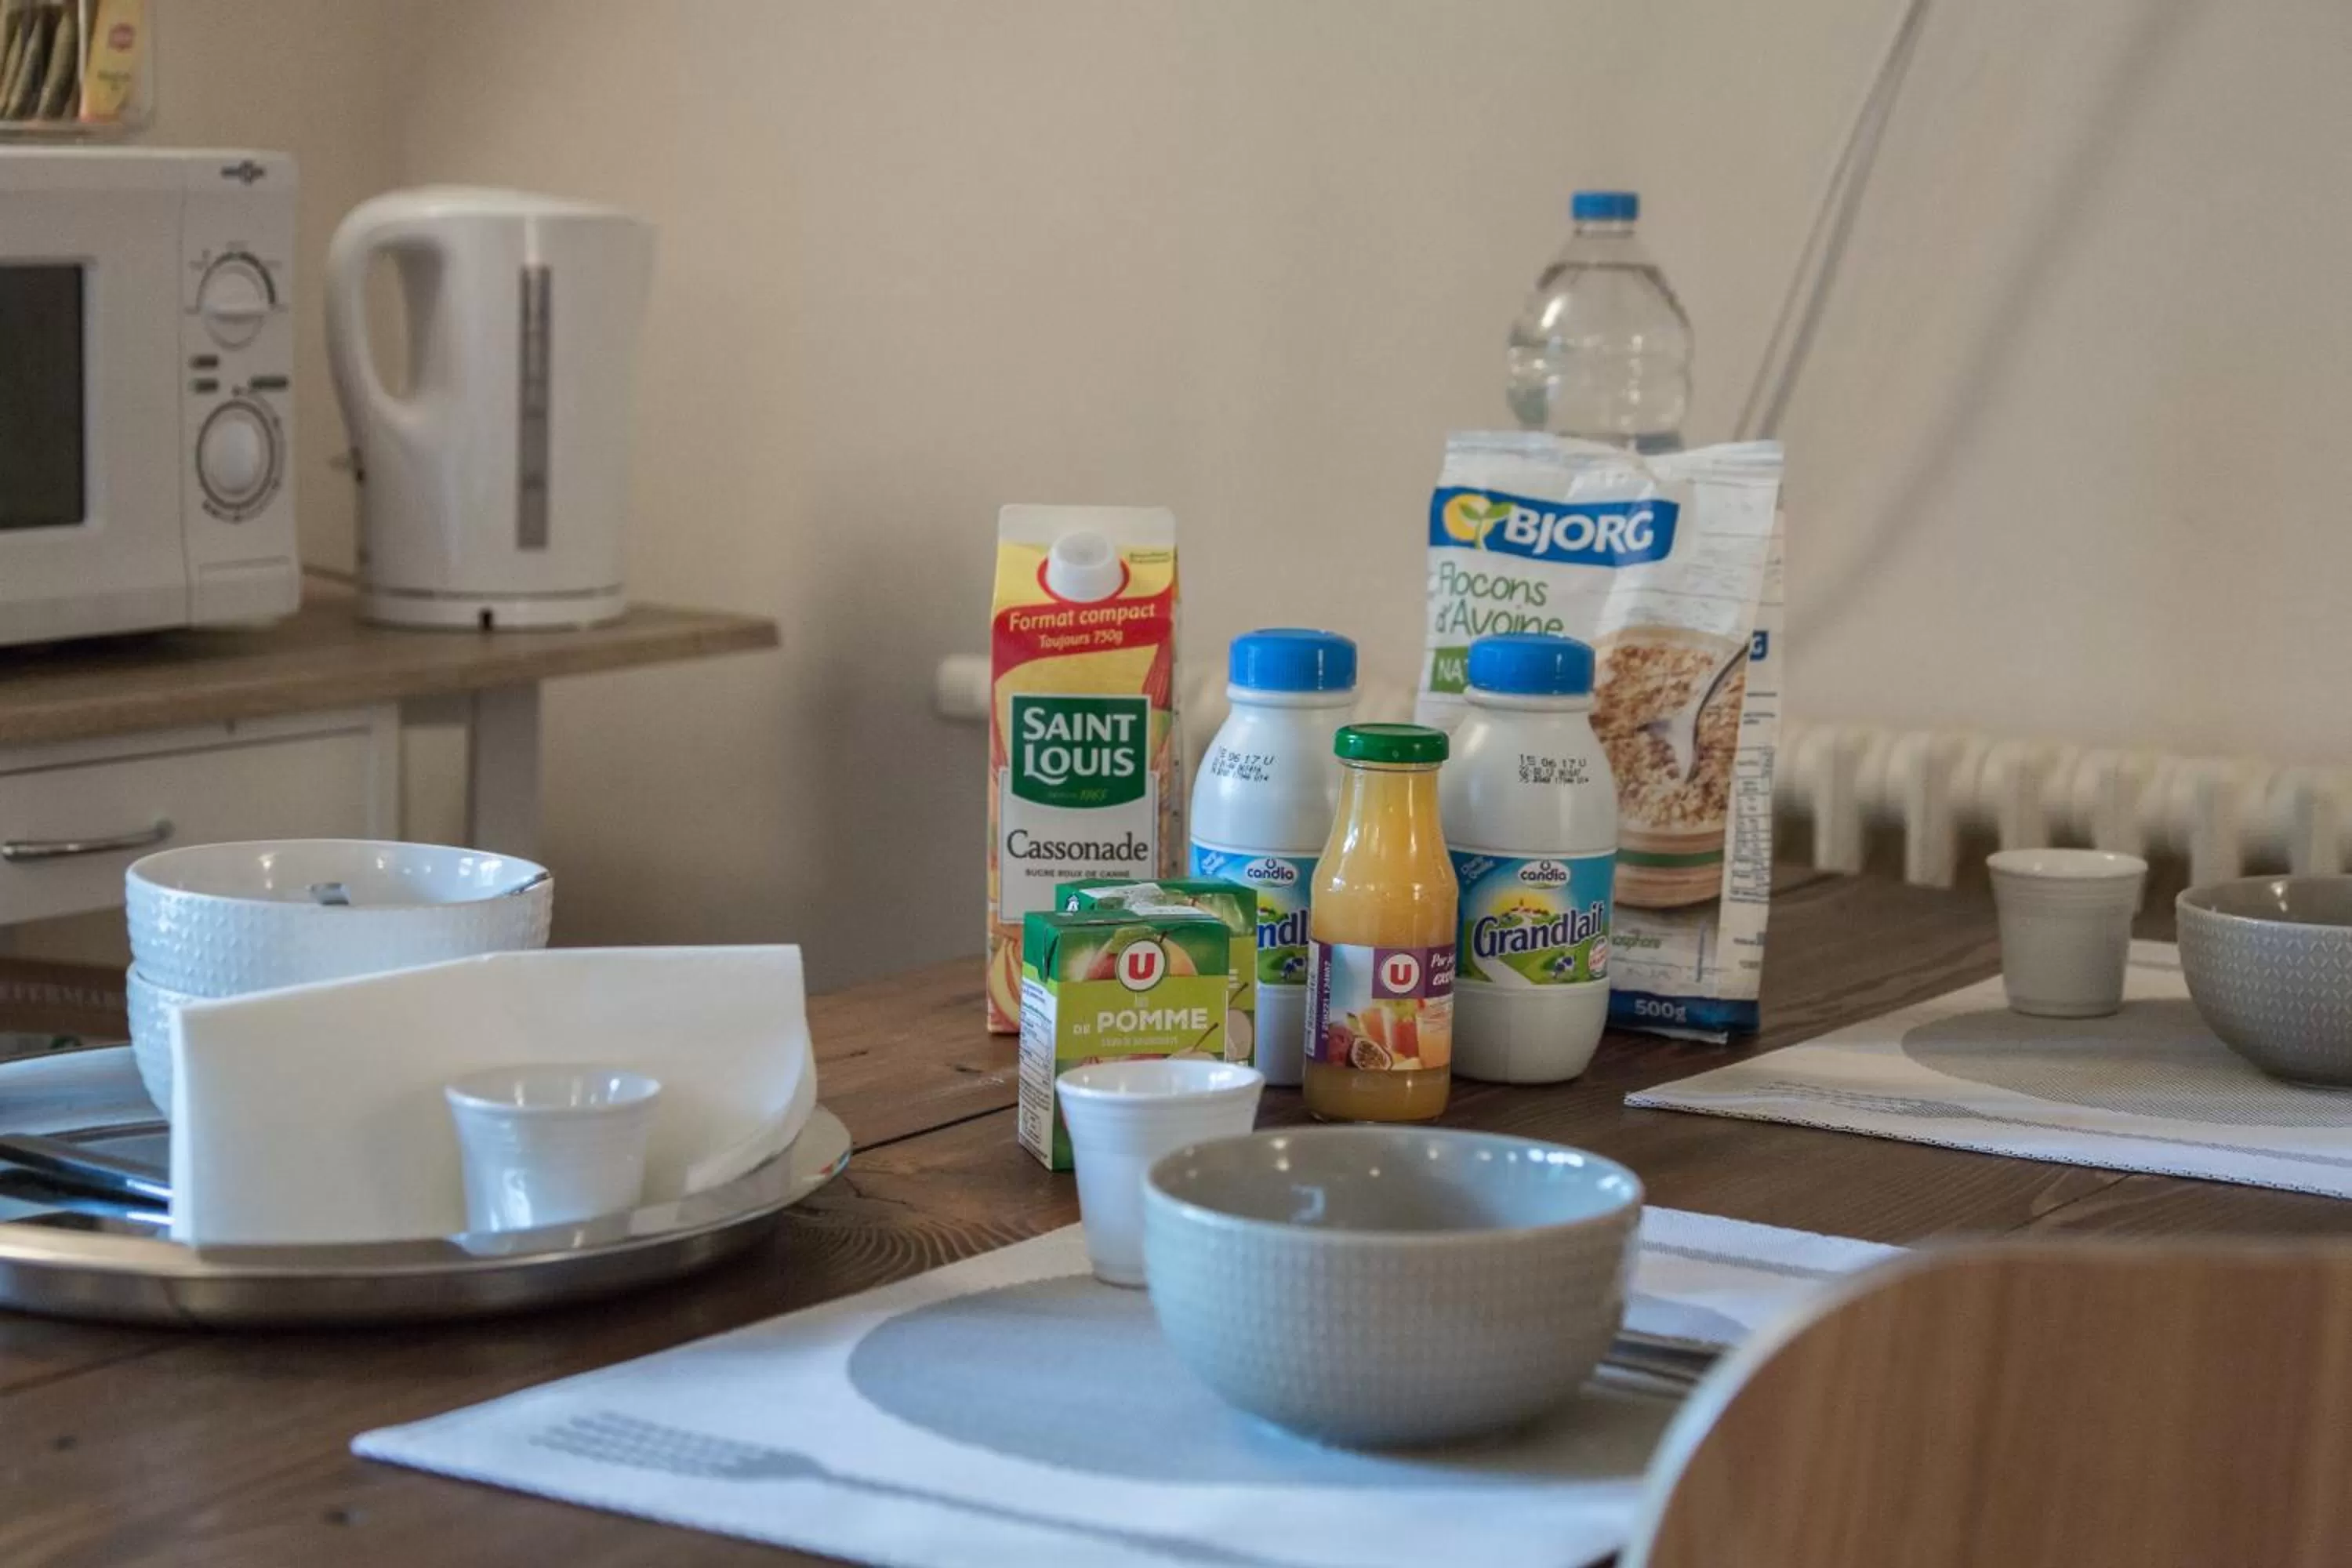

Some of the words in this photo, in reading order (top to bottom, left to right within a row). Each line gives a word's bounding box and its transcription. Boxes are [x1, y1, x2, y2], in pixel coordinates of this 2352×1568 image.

[1504, 506, 1654, 555] BJORG
[1009, 610, 1074, 632] Format
[1079, 603, 1155, 625] compact
[1039, 633, 1091, 650] Toujours
[1094, 629, 1123, 644] 750g
[1022, 706, 1138, 743] SAINT
[1023, 743, 1136, 786] LOUIS
[1007, 828, 1149, 862] Cassonade
[1247, 866, 1294, 880] candia
[1520, 868, 1567, 881] candia
[1473, 902, 1603, 958] Grandlait
[1128, 953, 1156, 980] U
[1390, 964, 1412, 985] U
[1073, 1024, 1091, 1035] DE
[1098, 1007, 1208, 1033] POMME
[1634, 999, 1686, 1023] 500g
